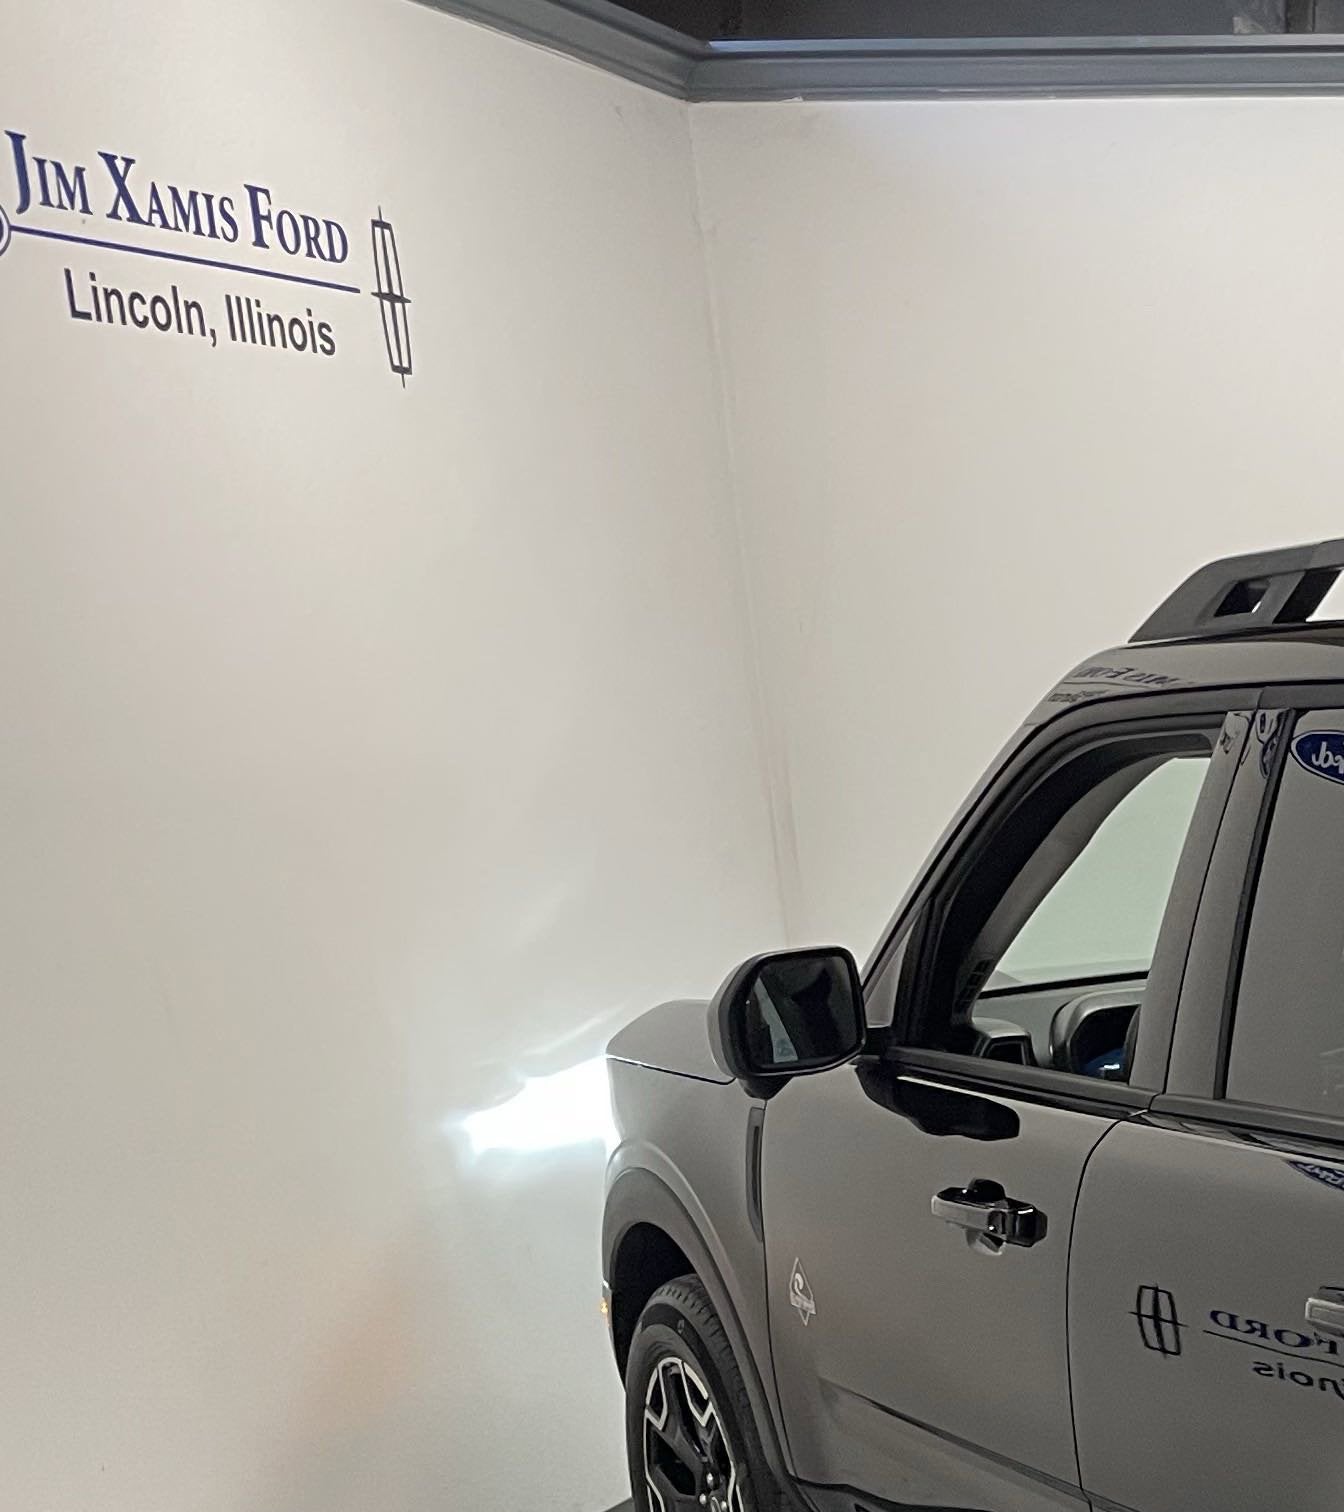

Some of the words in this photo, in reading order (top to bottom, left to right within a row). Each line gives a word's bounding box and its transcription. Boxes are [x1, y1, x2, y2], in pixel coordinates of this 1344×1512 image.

[4, 130, 93, 215] JIM
[97, 150, 239, 243] XAMIS
[244, 183, 349, 264] FORD
[64, 268, 218, 348] Lincoln,
[224, 294, 336, 356] Illinois
